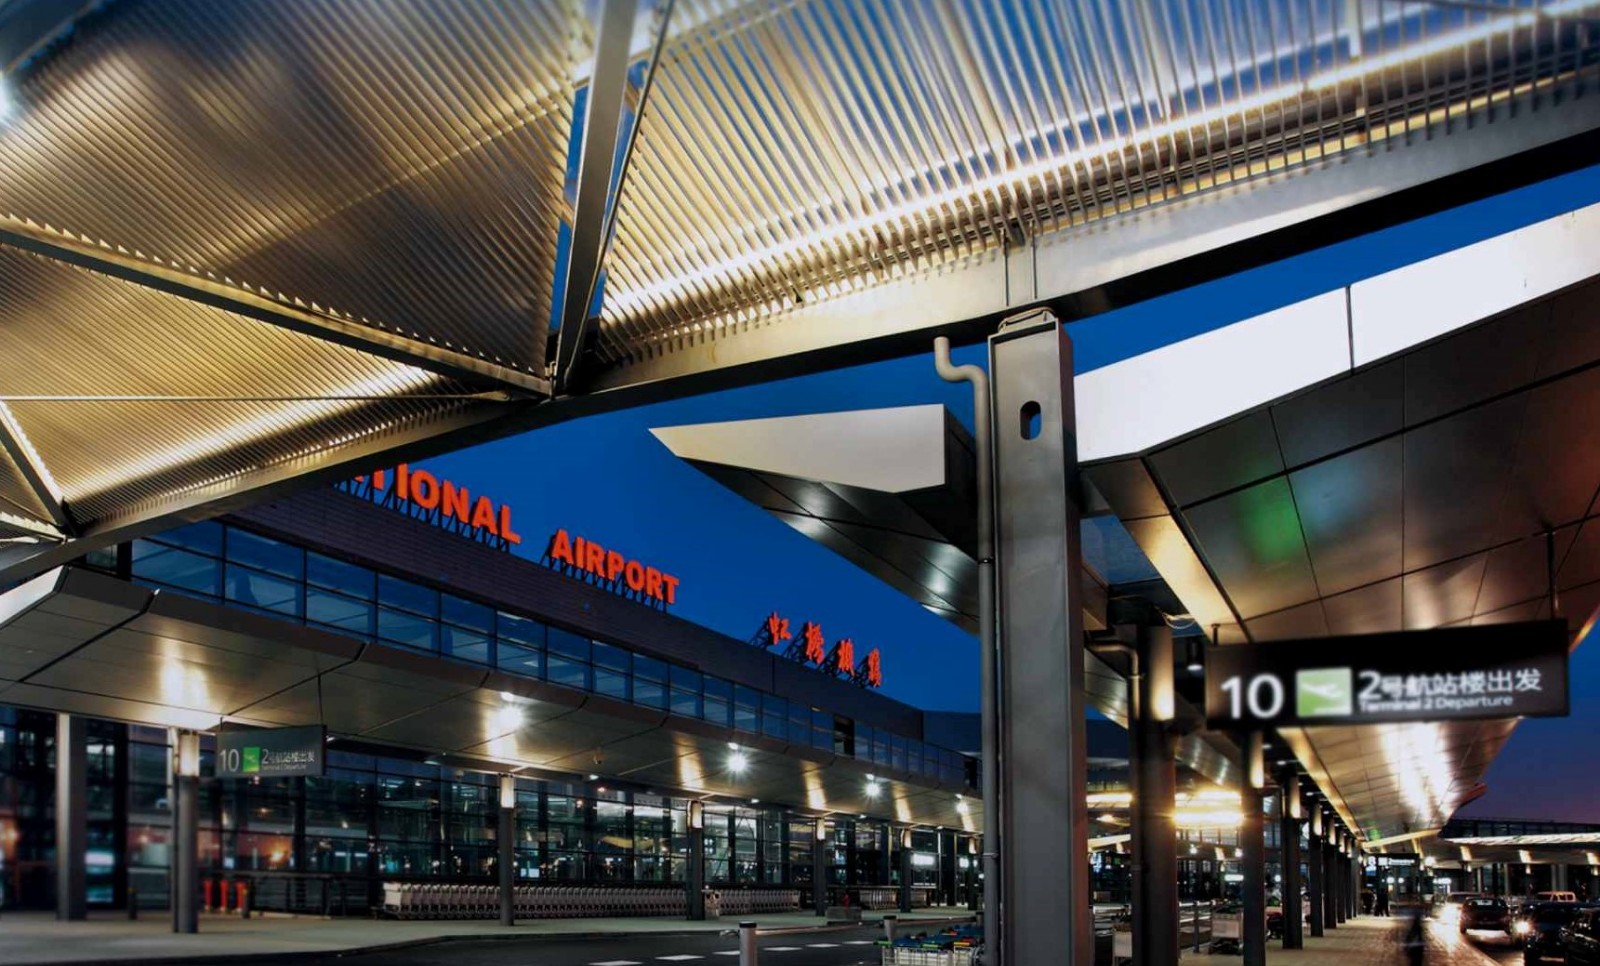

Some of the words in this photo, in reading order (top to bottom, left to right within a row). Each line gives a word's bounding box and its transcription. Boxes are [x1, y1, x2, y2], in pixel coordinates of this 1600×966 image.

[551, 529, 679, 604] AIRPORT
[1221, 674, 1284, 718] 10
[1358, 668, 1542, 702] 2号航站楼出发
[1435, 695, 1513, 710] Departure
[219, 748, 240, 772] 10
